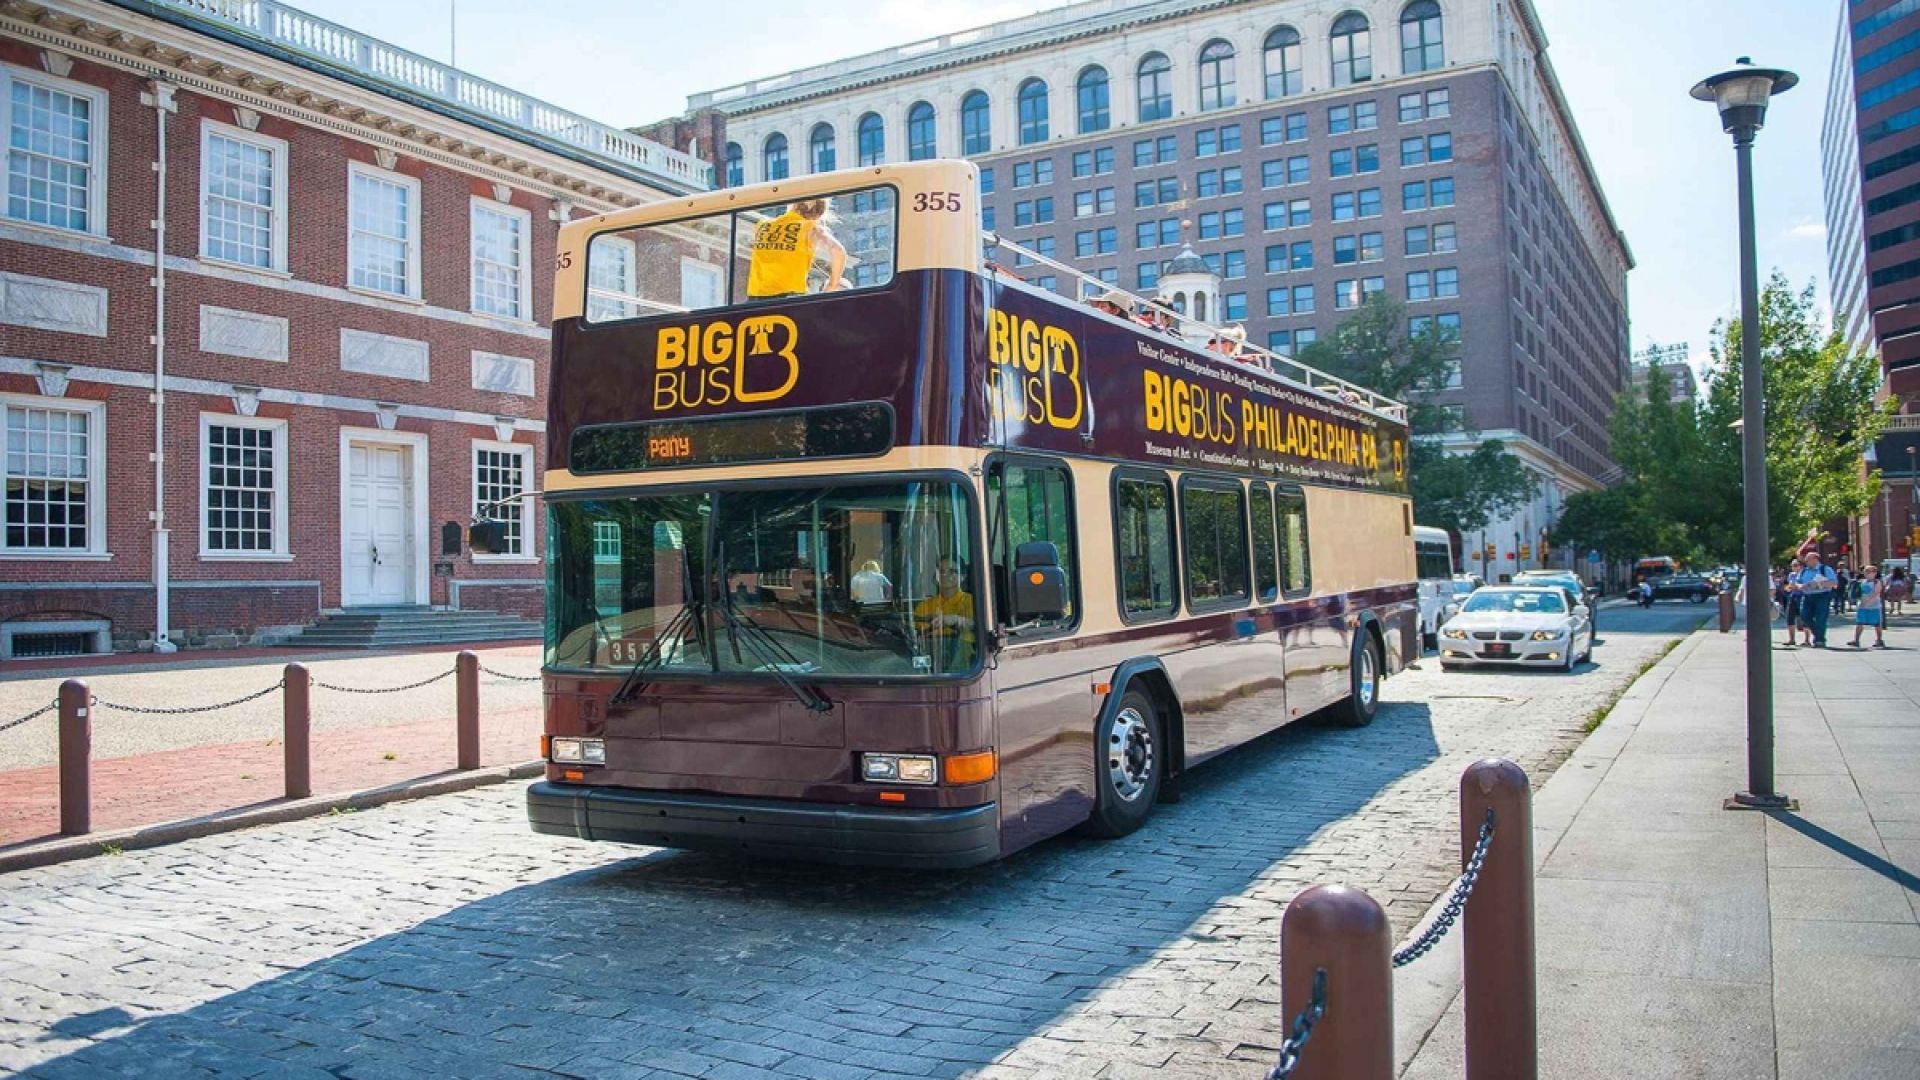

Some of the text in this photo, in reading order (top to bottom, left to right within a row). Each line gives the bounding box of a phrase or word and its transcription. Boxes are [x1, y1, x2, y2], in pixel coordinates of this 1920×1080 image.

[913, 191, 961, 212] 355
[656, 321, 733, 369] BIG
[989, 308, 1041, 373] BIG
[1160, 348, 1179, 367] Center
[654, 367, 731, 410] BUS
[991, 368, 1045, 424] BUS
[1145, 441, 1172, 457] Museum
[1173, 446, 1180, 458] of
[1181, 446, 1191, 459] Art
[1242, 399, 1359, 467] PHILADELPHIA
[1361, 431, 1378, 470] PA
